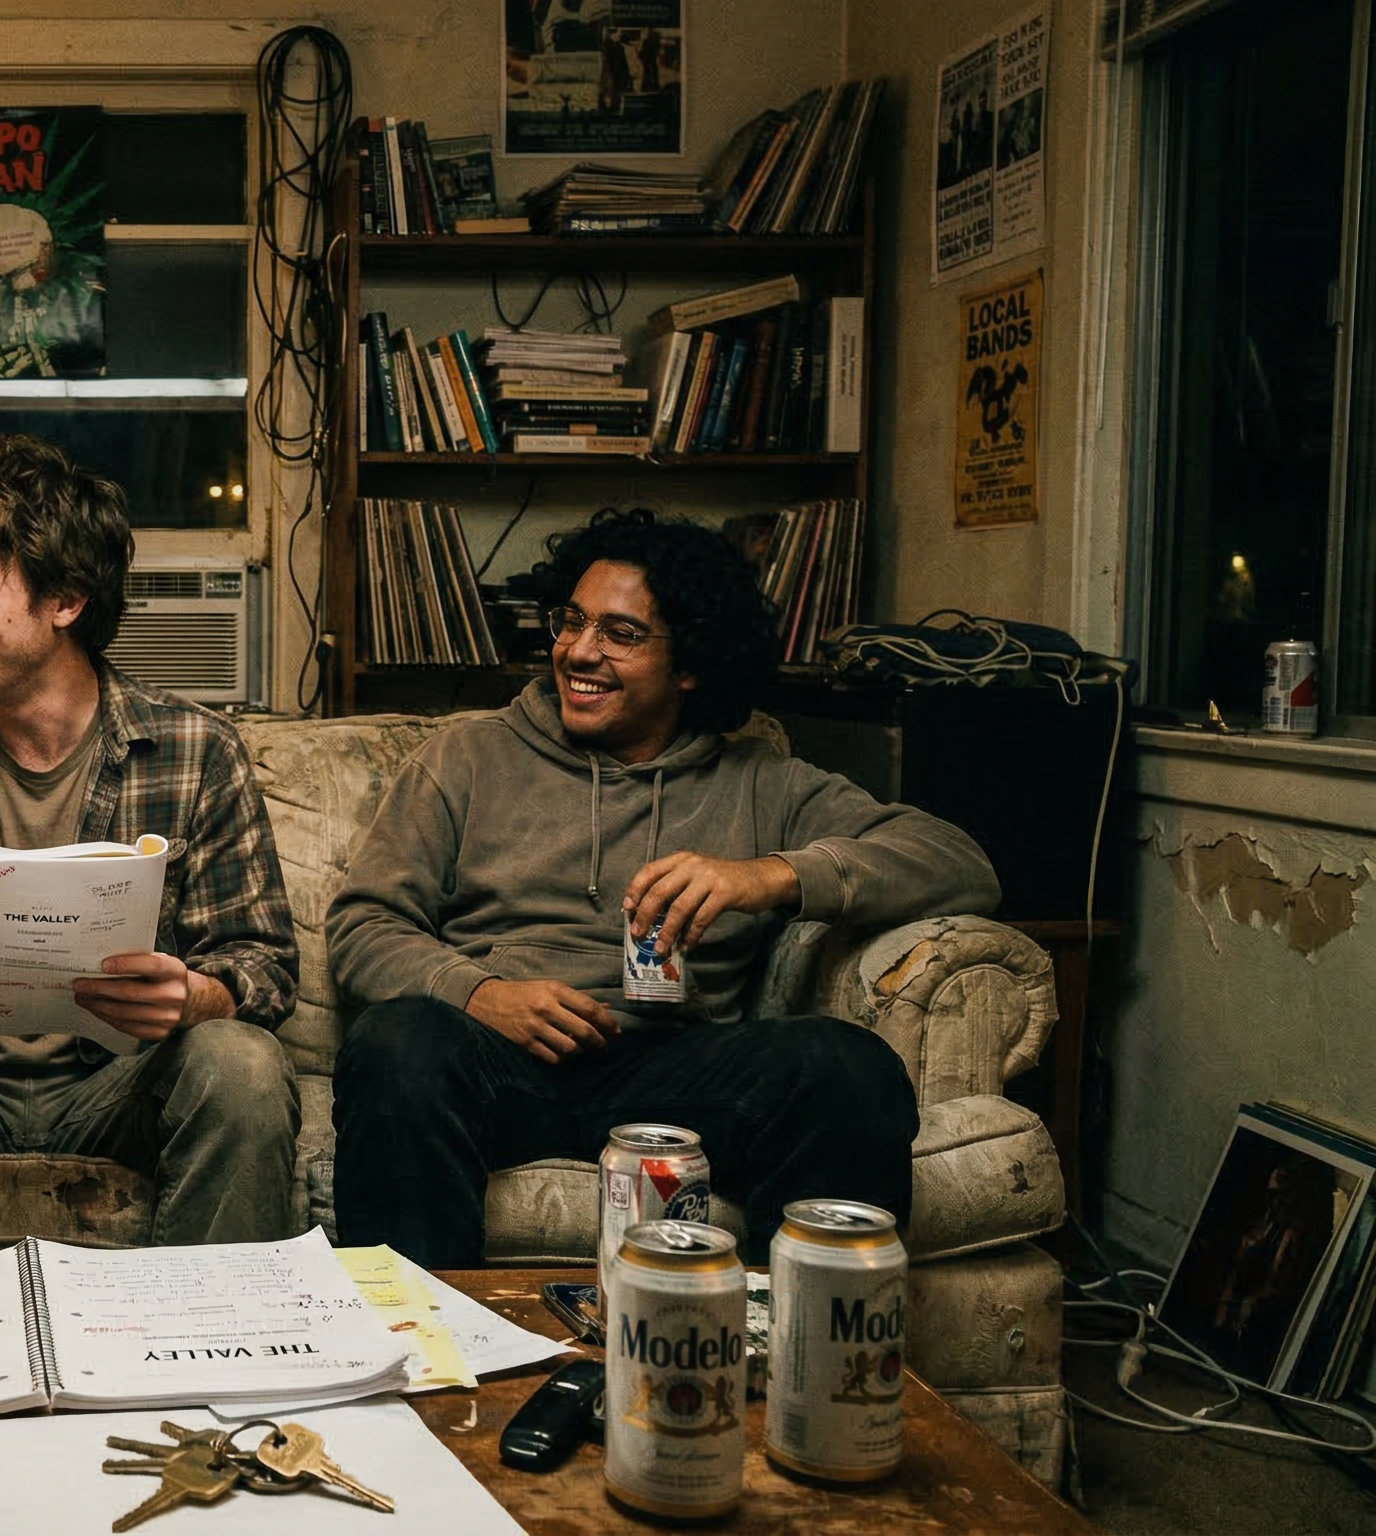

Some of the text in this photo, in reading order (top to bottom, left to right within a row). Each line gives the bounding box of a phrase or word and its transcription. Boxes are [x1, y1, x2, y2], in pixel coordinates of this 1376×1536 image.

[968, 290, 1031, 334] LOCAL
[966, 319, 1033, 361] BANDS
[3, 913, 80, 923] THE VALLEY
[143, 1342, 320, 1362] THE VALLEY
[620, 1312, 742, 1371] Modelo
